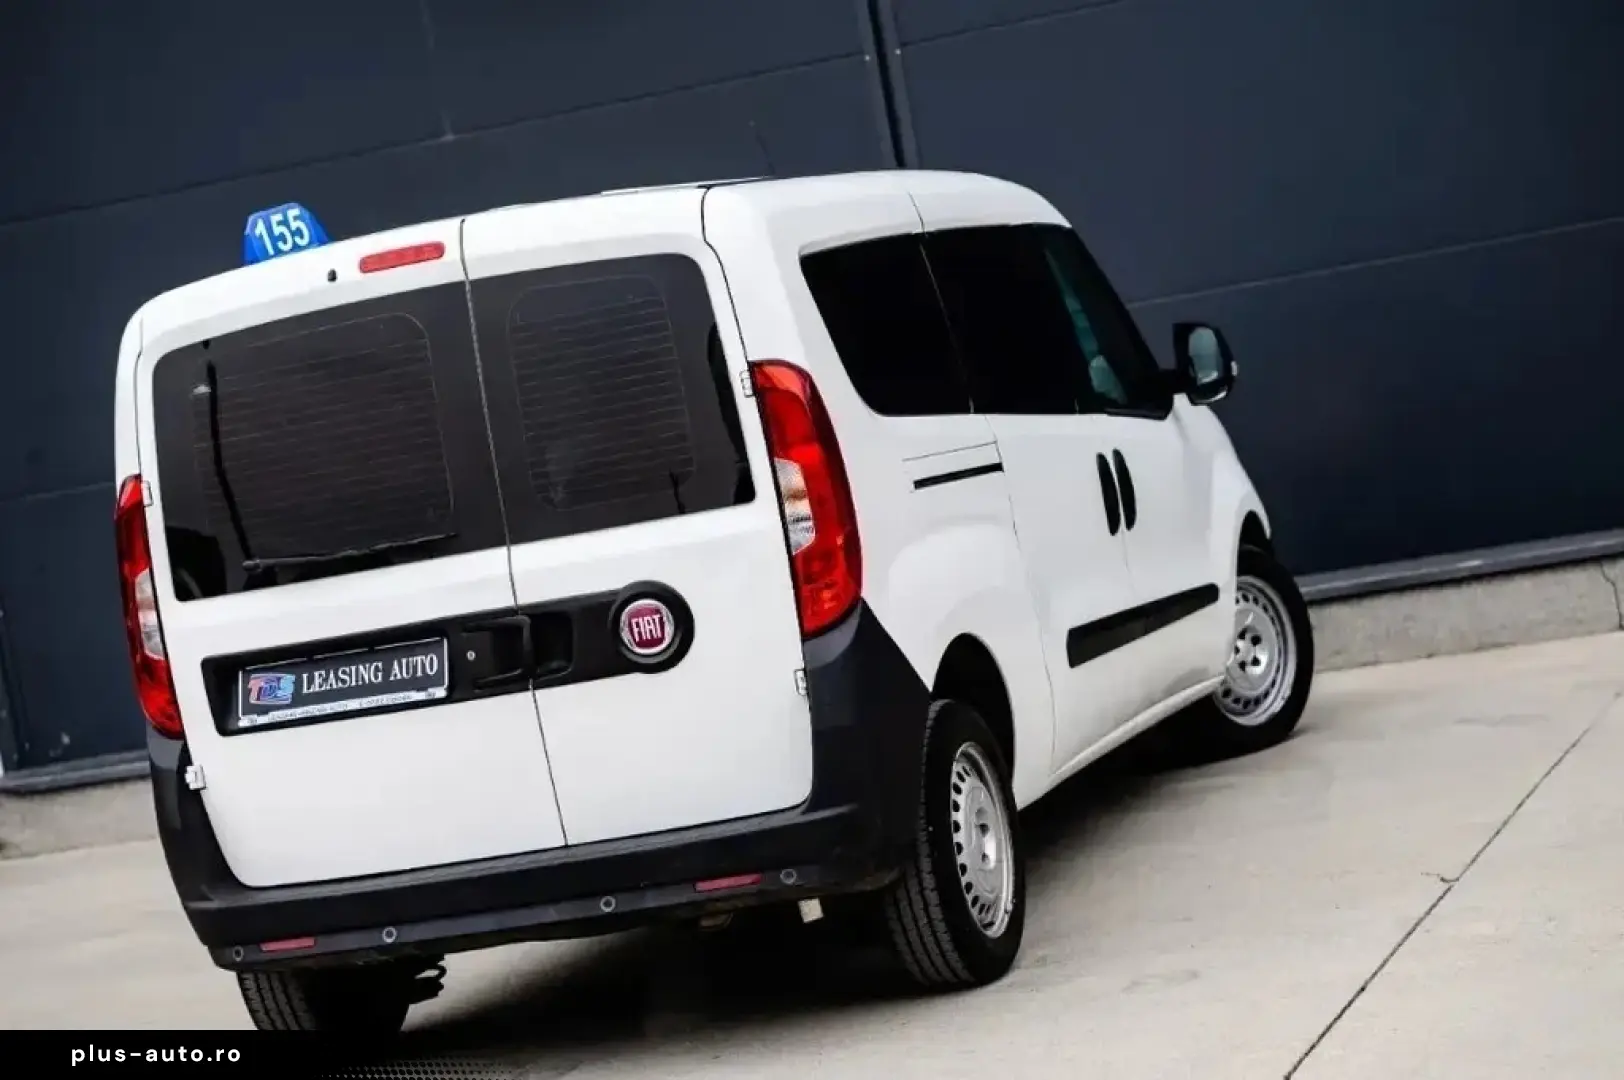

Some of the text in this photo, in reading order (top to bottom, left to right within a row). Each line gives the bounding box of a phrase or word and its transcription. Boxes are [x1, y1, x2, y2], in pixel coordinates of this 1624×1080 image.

[255, 207, 309, 255] 155
[631, 614, 662, 642] FIAT
[302, 662, 383, 693] LEASING
[389, 653, 438, 681] AUTO
